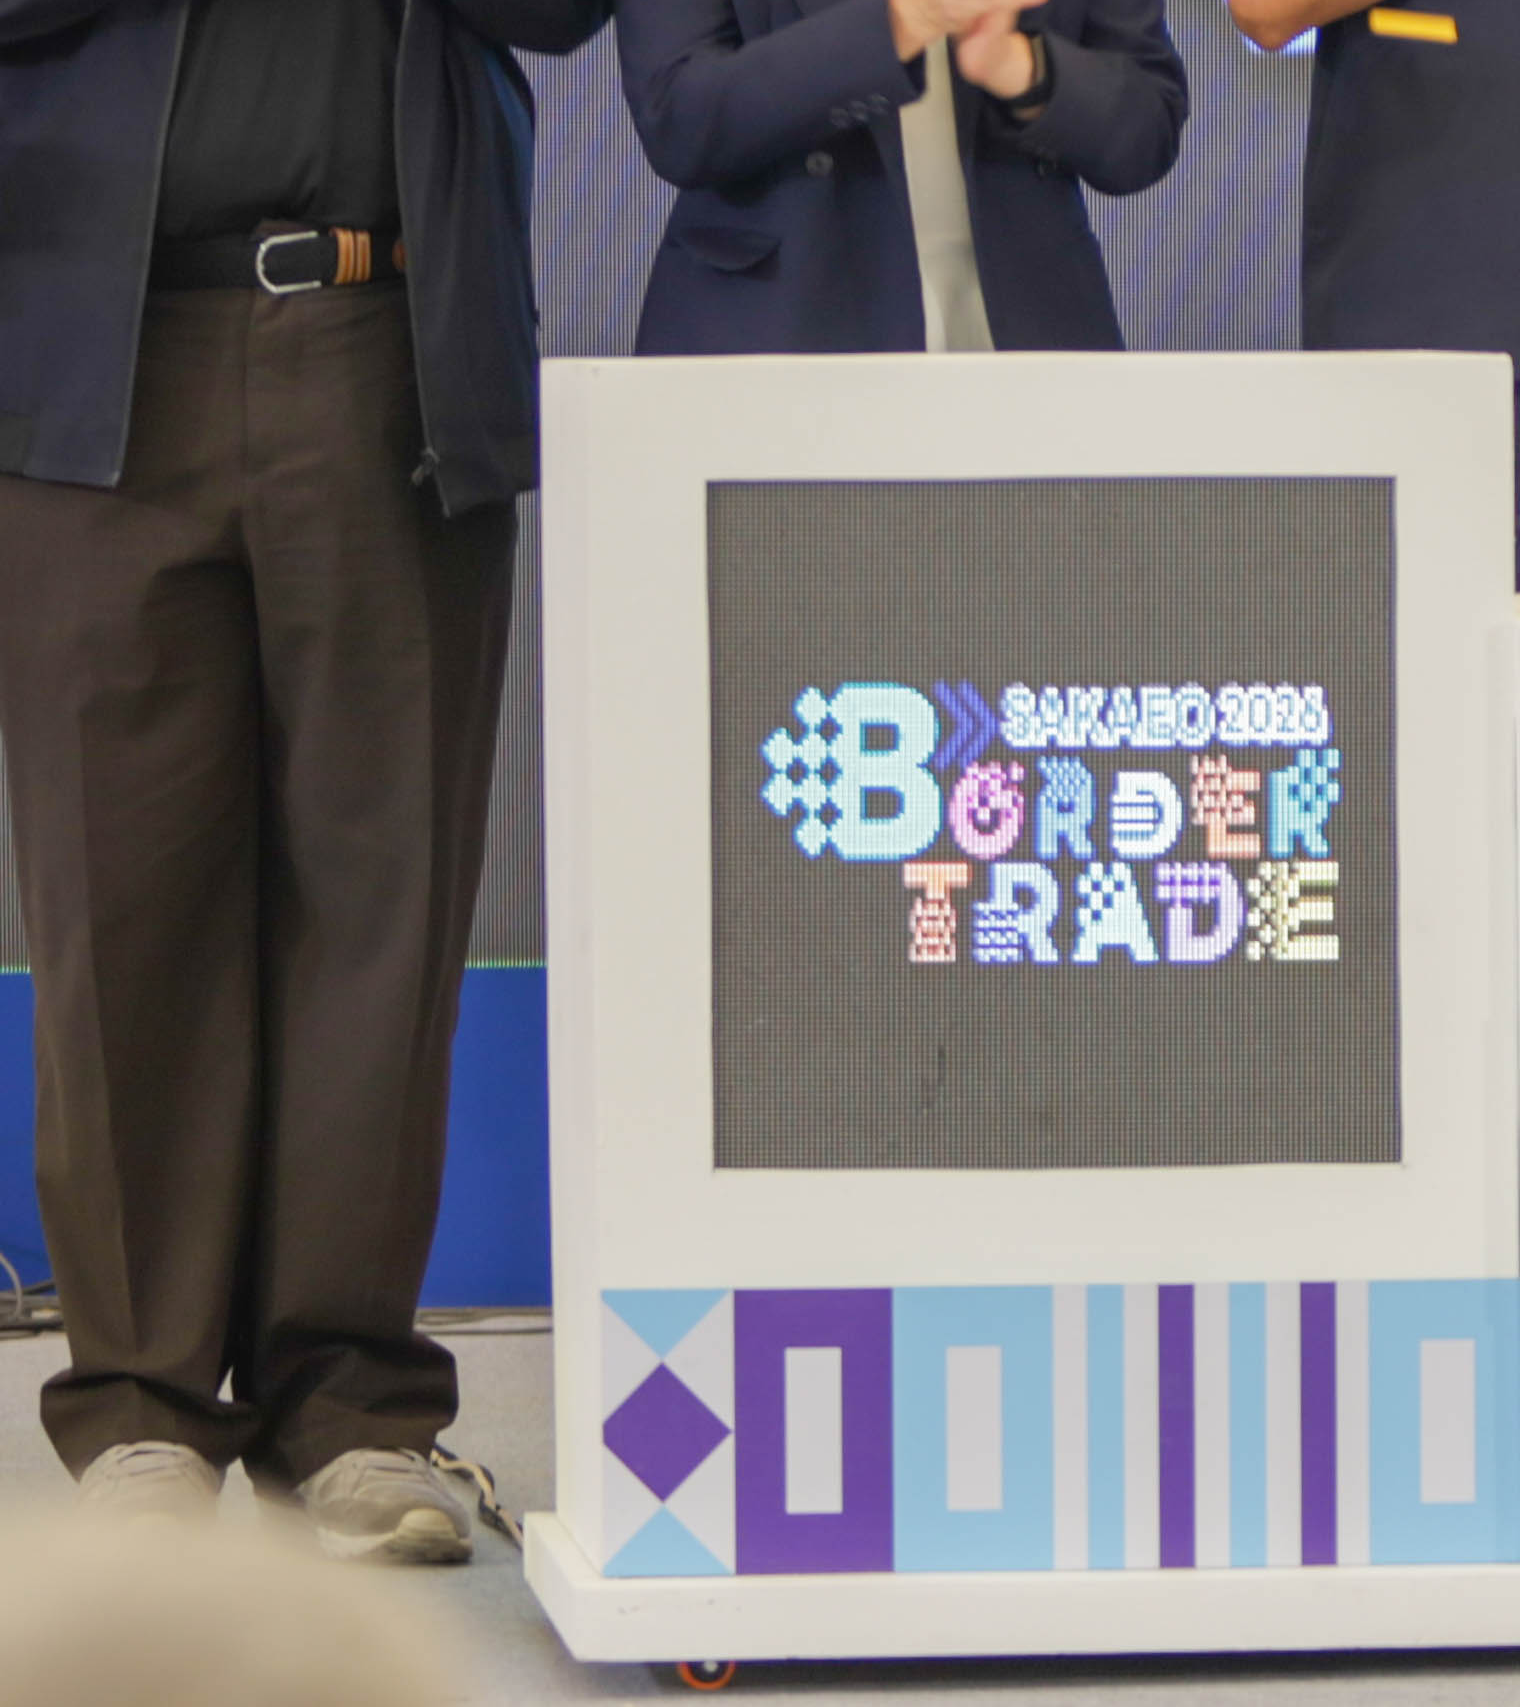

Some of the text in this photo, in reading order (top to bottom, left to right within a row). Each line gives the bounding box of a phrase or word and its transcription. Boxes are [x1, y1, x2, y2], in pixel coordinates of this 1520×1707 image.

[999, 680, 1333, 750] SAKAEO 2026
[760, 681, 1342, 862] BORDER
[903, 860, 1341, 964] TRADE
